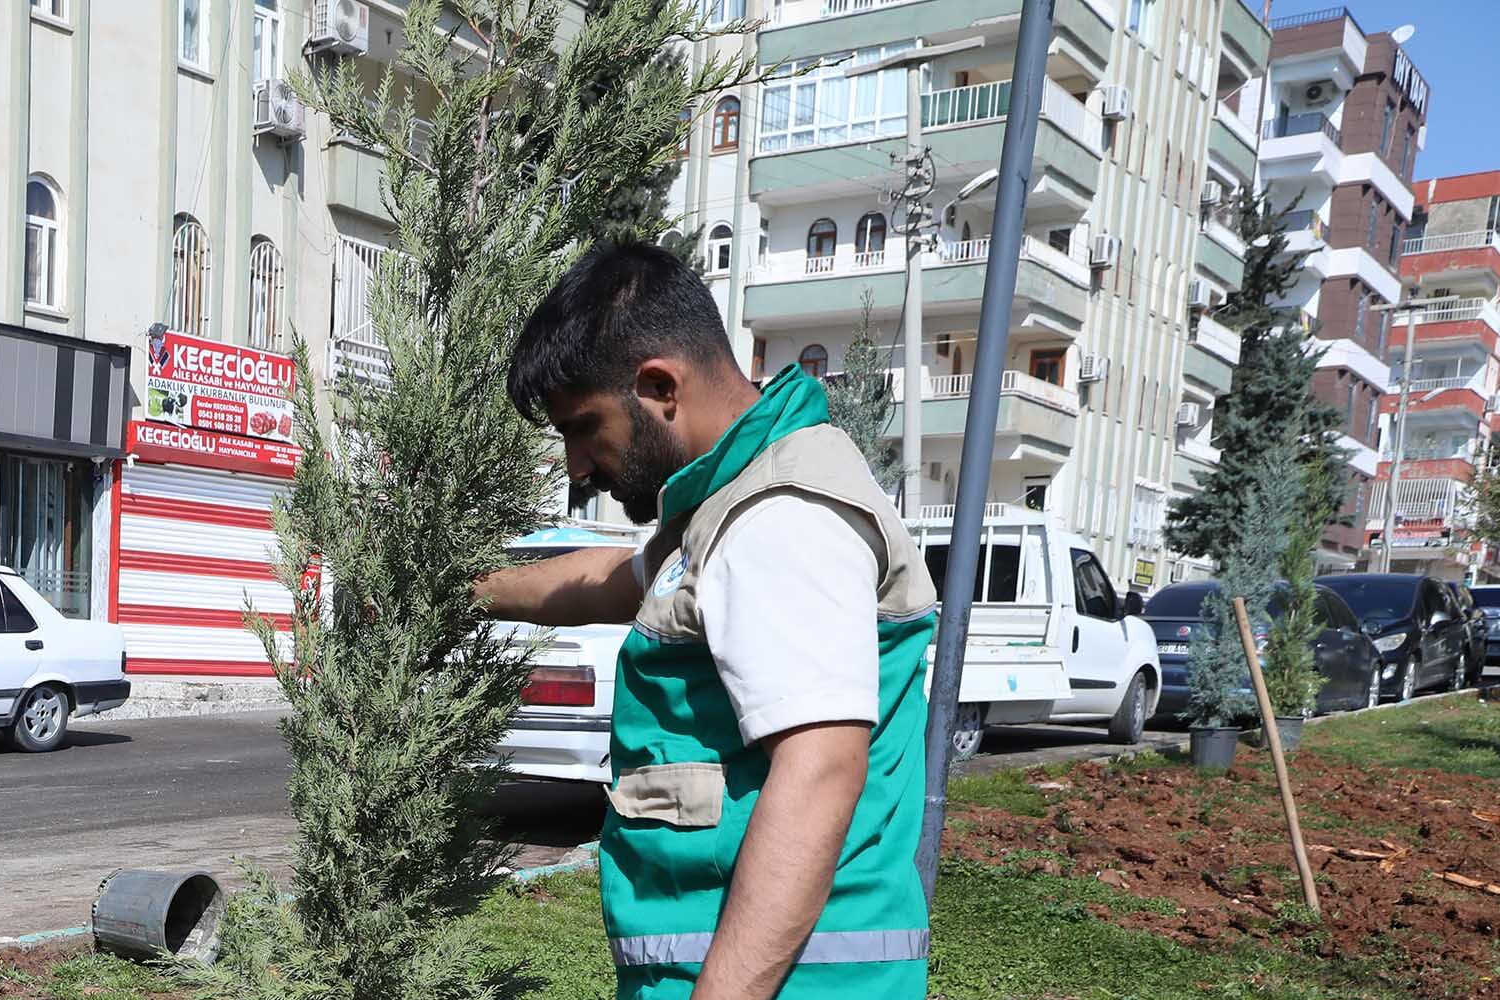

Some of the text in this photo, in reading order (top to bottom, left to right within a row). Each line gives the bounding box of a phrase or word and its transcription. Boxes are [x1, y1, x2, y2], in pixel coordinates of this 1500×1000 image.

[172, 368, 191, 381] AİLE
[192, 373, 222, 387] KASABI
[223, 380, 234, 388] ve
[173, 343, 291, 388] KEÇECİOĞLU
[148, 378, 287, 409] ADAKLIK VE KURBANLIK BULUNUR
[137, 425, 215, 453] KEÇECİOĞLU
[218, 447, 258, 459] HAYVANCILIK
